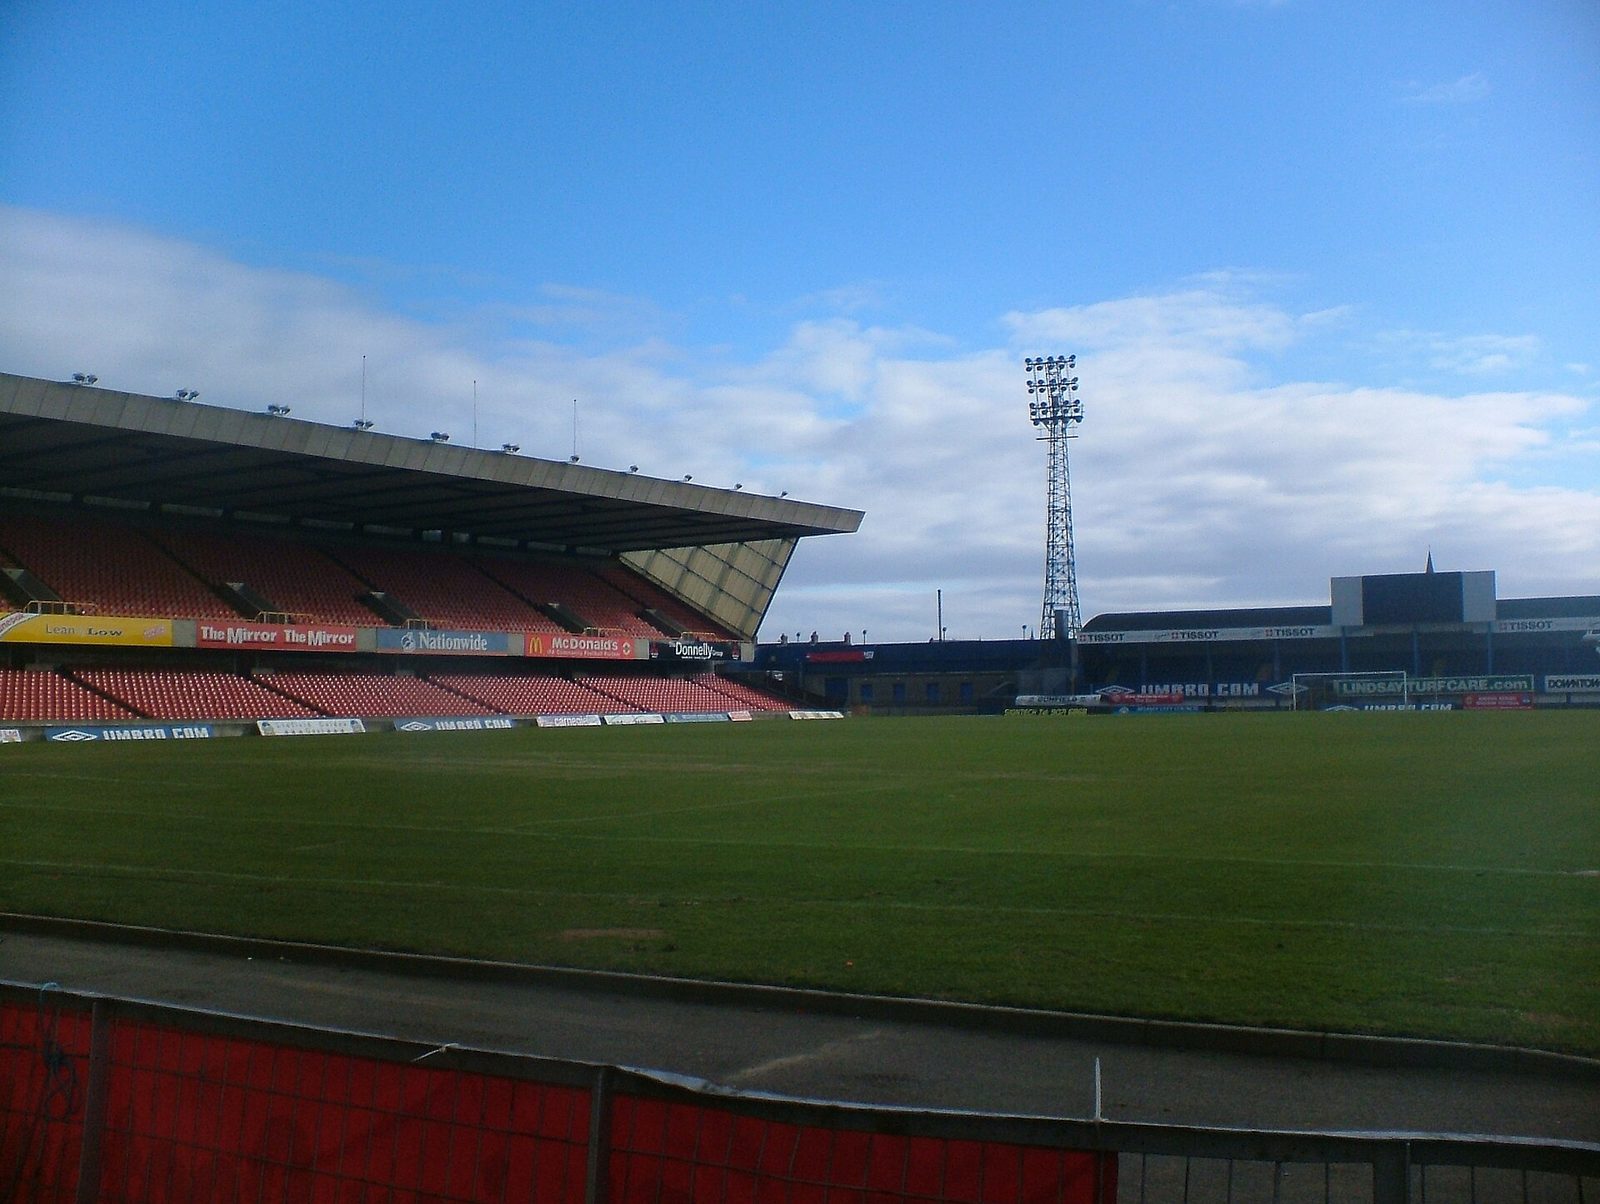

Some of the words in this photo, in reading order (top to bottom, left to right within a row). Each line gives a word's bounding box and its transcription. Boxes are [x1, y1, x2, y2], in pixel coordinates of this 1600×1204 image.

[46, 623, 75, 635] Lean
[1511, 620, 1553, 630] TISSOT
[201, 626, 225, 640] The
[227, 627, 277, 644] Mirror
[284, 629, 306, 643] The
[307, 630, 355, 646] Mirror
[1088, 633, 1125, 642] TISSOT
[1181, 631, 1219, 640] TISSOT
[1274, 627, 1315, 637] TISSOT
[419, 632, 488, 651] Nationwide
[552, 637, 618, 651] McDonald's
[675, 641, 713, 659] Donnelly
